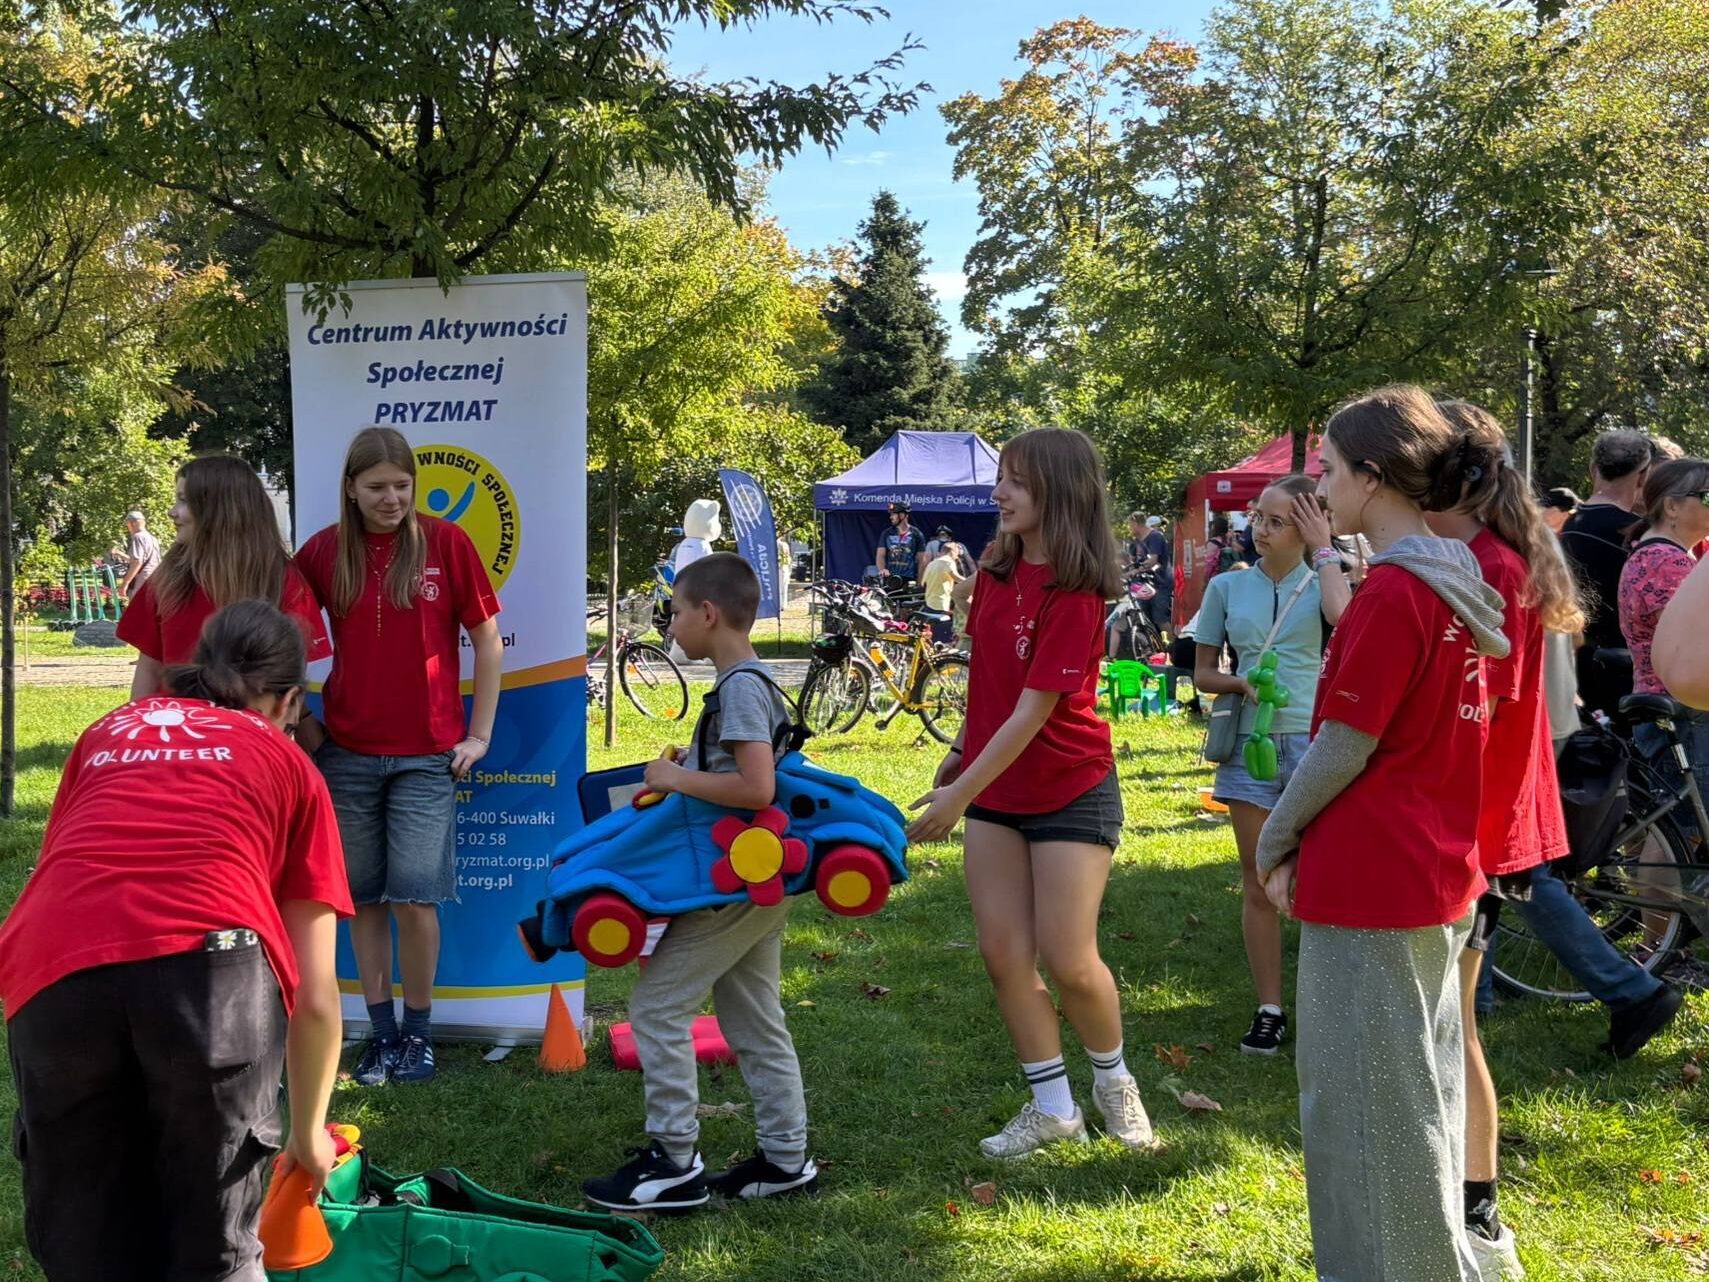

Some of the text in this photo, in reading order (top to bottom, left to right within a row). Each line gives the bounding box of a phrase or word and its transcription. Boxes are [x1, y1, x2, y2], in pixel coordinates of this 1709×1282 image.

[307, 313, 568, 345] Centrum Aktywności
[366, 356, 504, 388] Społecznej
[374, 399, 498, 424] PRYZMAT
[854, 493, 901, 503] Komenda
[903, 493, 943, 506] Miejska
[945, 495, 976, 507] Policji
[977, 497, 988, 505] w
[481, 473, 514, 575] SPOŁECZNEJ
[475, 770, 556, 787] Społecznej
[457, 811, 555, 825] 6-400 Suwałki
[468, 833, 485, 846] 02
[489, 833, 507, 846] 58
[457, 874, 513, 890] t.org.pl
